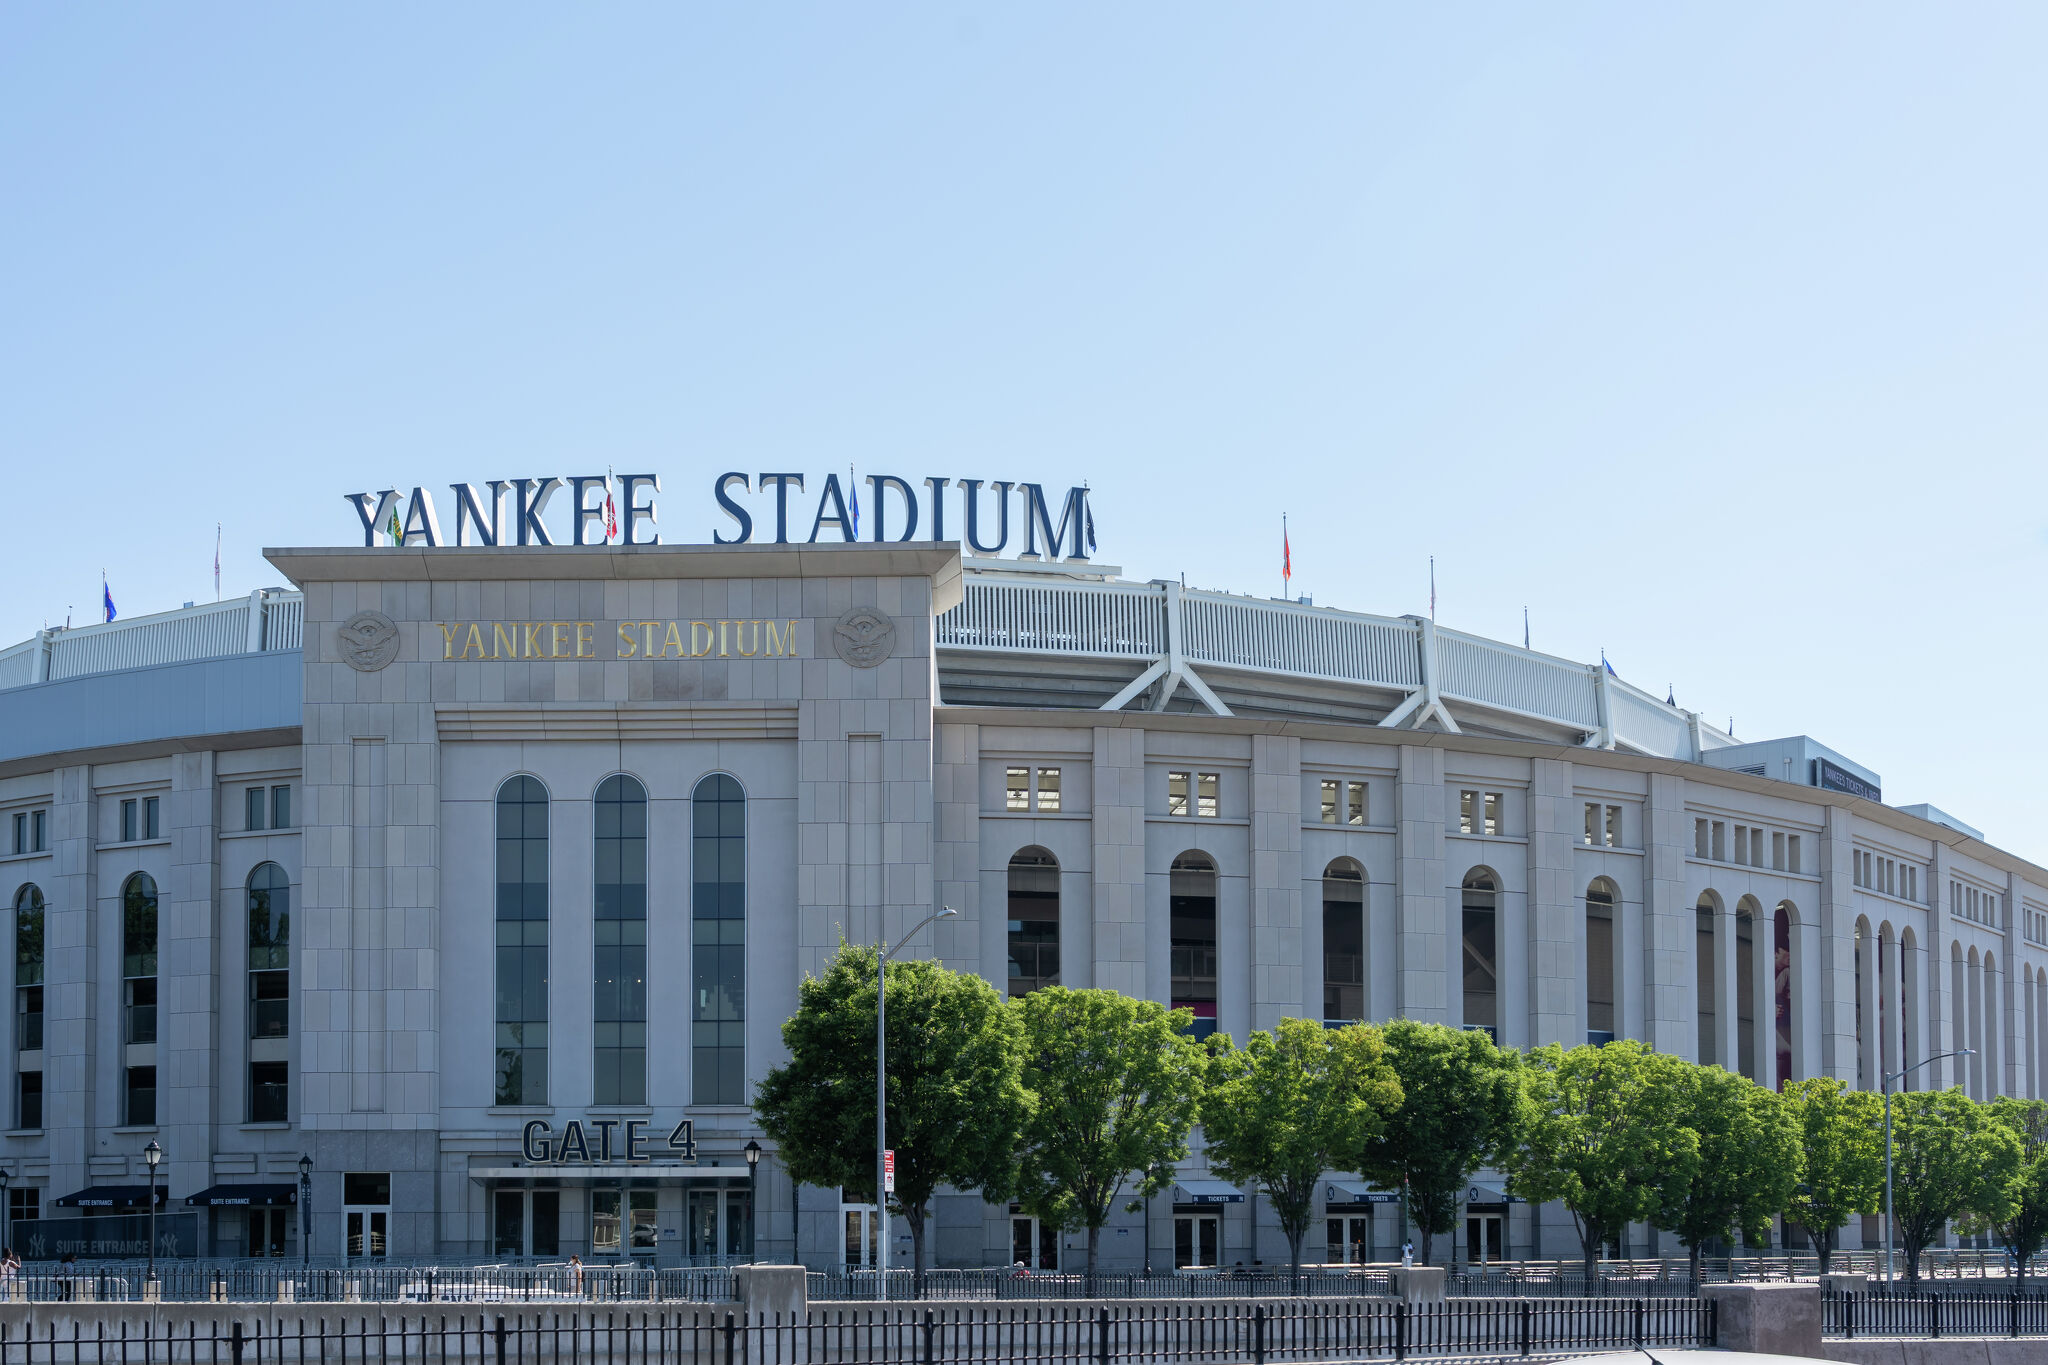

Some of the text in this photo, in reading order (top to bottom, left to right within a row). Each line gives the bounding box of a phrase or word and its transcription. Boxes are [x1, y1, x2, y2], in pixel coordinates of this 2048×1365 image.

[344, 471, 1092, 560] YANKEE STADIUM
[436, 620, 799, 660] YANKEE STADIUM
[1825, 766, 1845, 787] YANKEES
[1846, 777, 1864, 797] TICKETS
[523, 1119, 697, 1163] GATE 4
[56, 1240, 150, 1254] SUITE ENTRANCE
